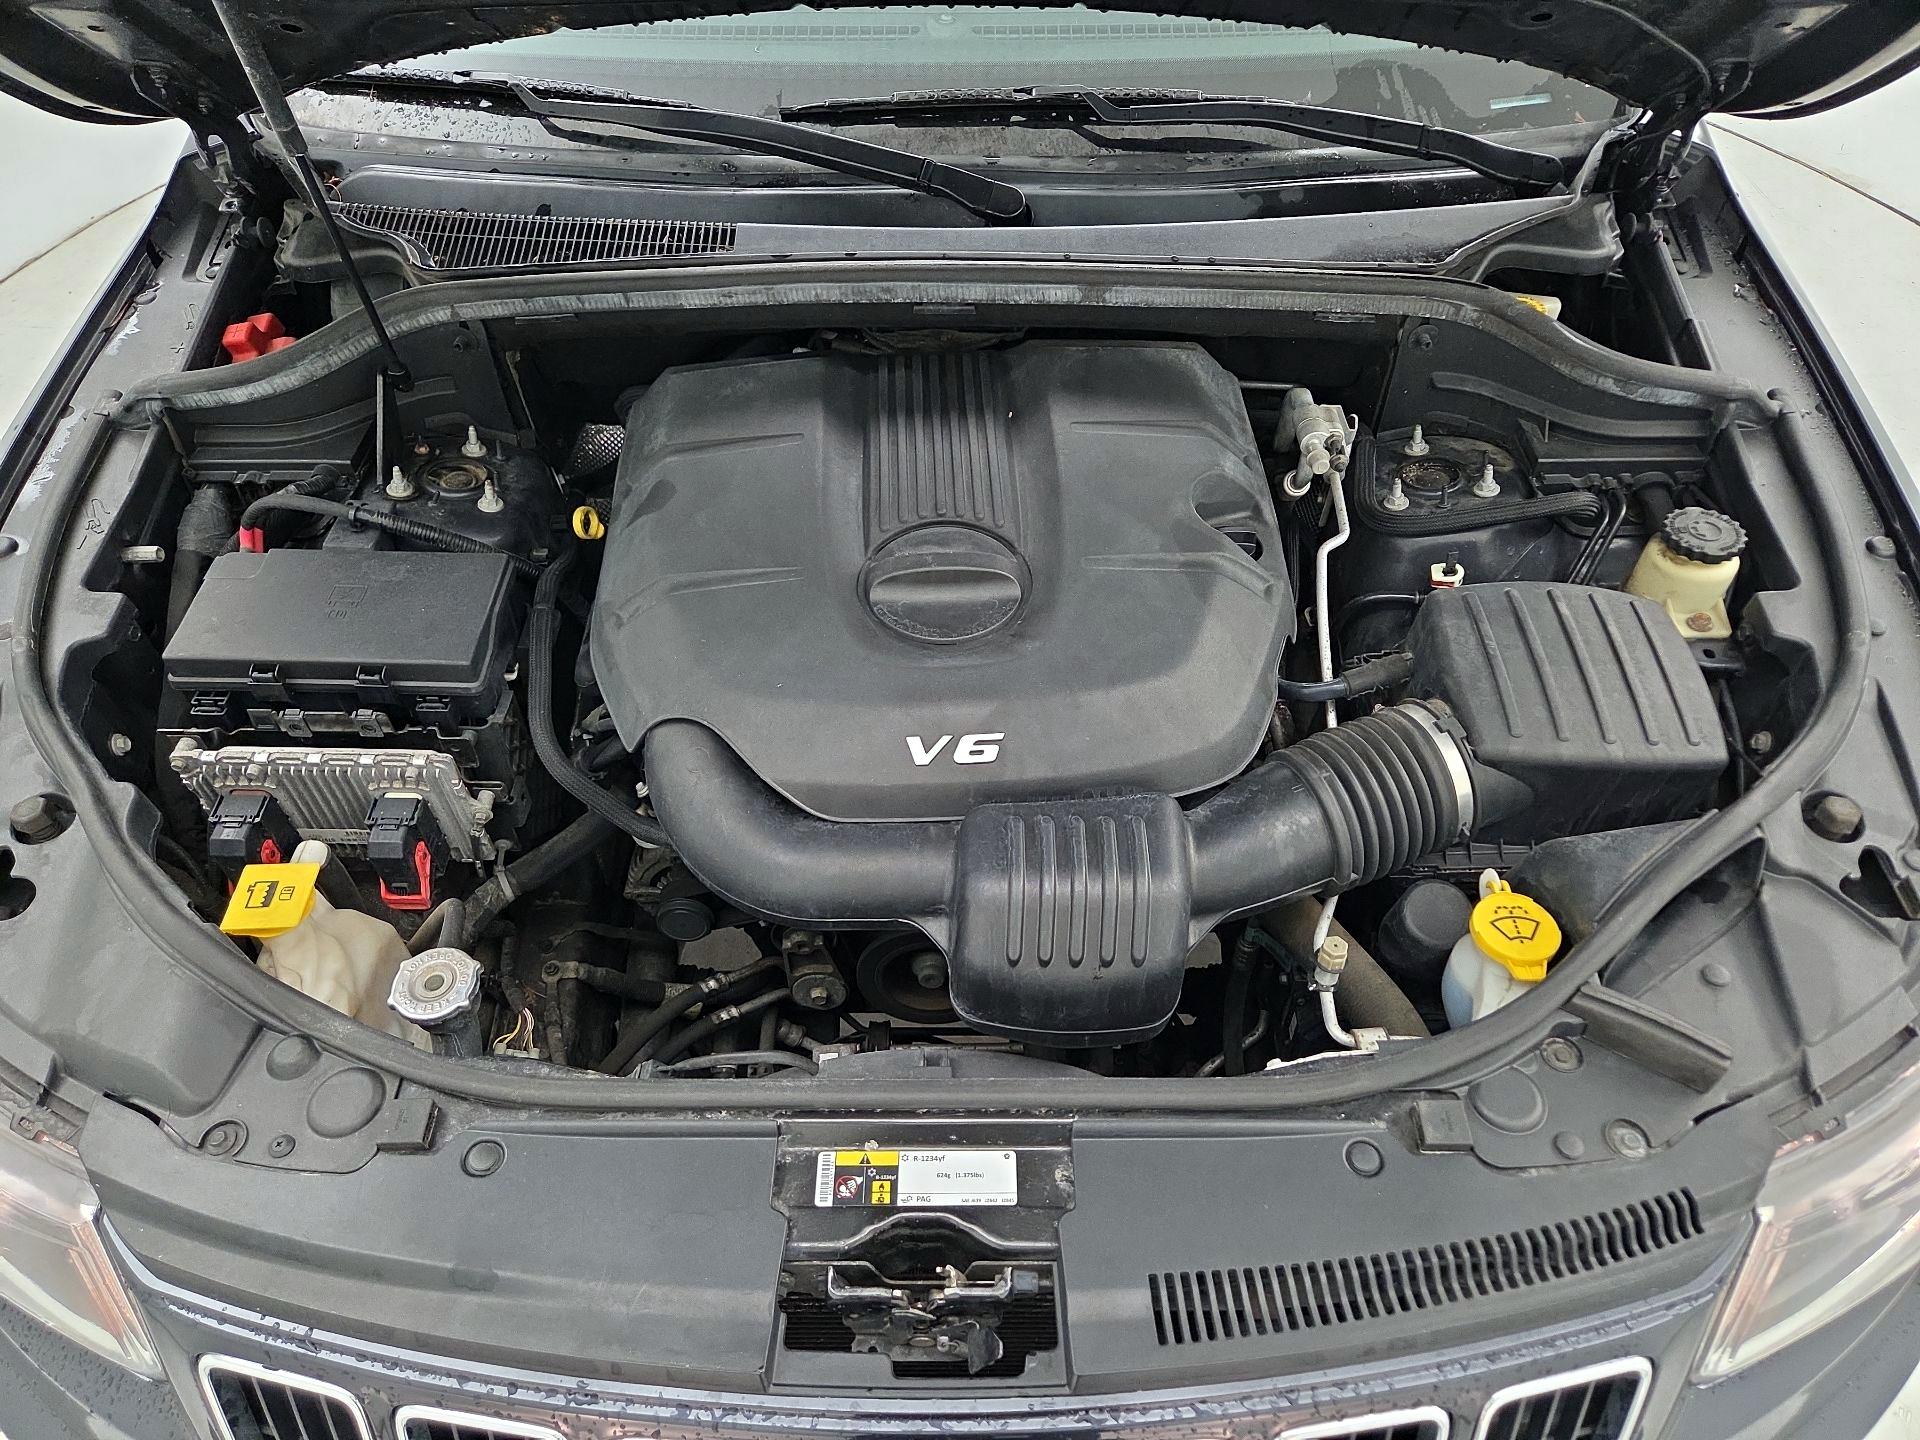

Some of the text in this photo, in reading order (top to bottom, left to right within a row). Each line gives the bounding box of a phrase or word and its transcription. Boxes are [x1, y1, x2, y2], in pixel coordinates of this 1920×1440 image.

[905, 732, 1006, 766] V6
[913, 1155, 946, 1163] R-1234yf
[936, 1172, 951, 1180] 624g
[916, 1195, 932, 1203] PAG
